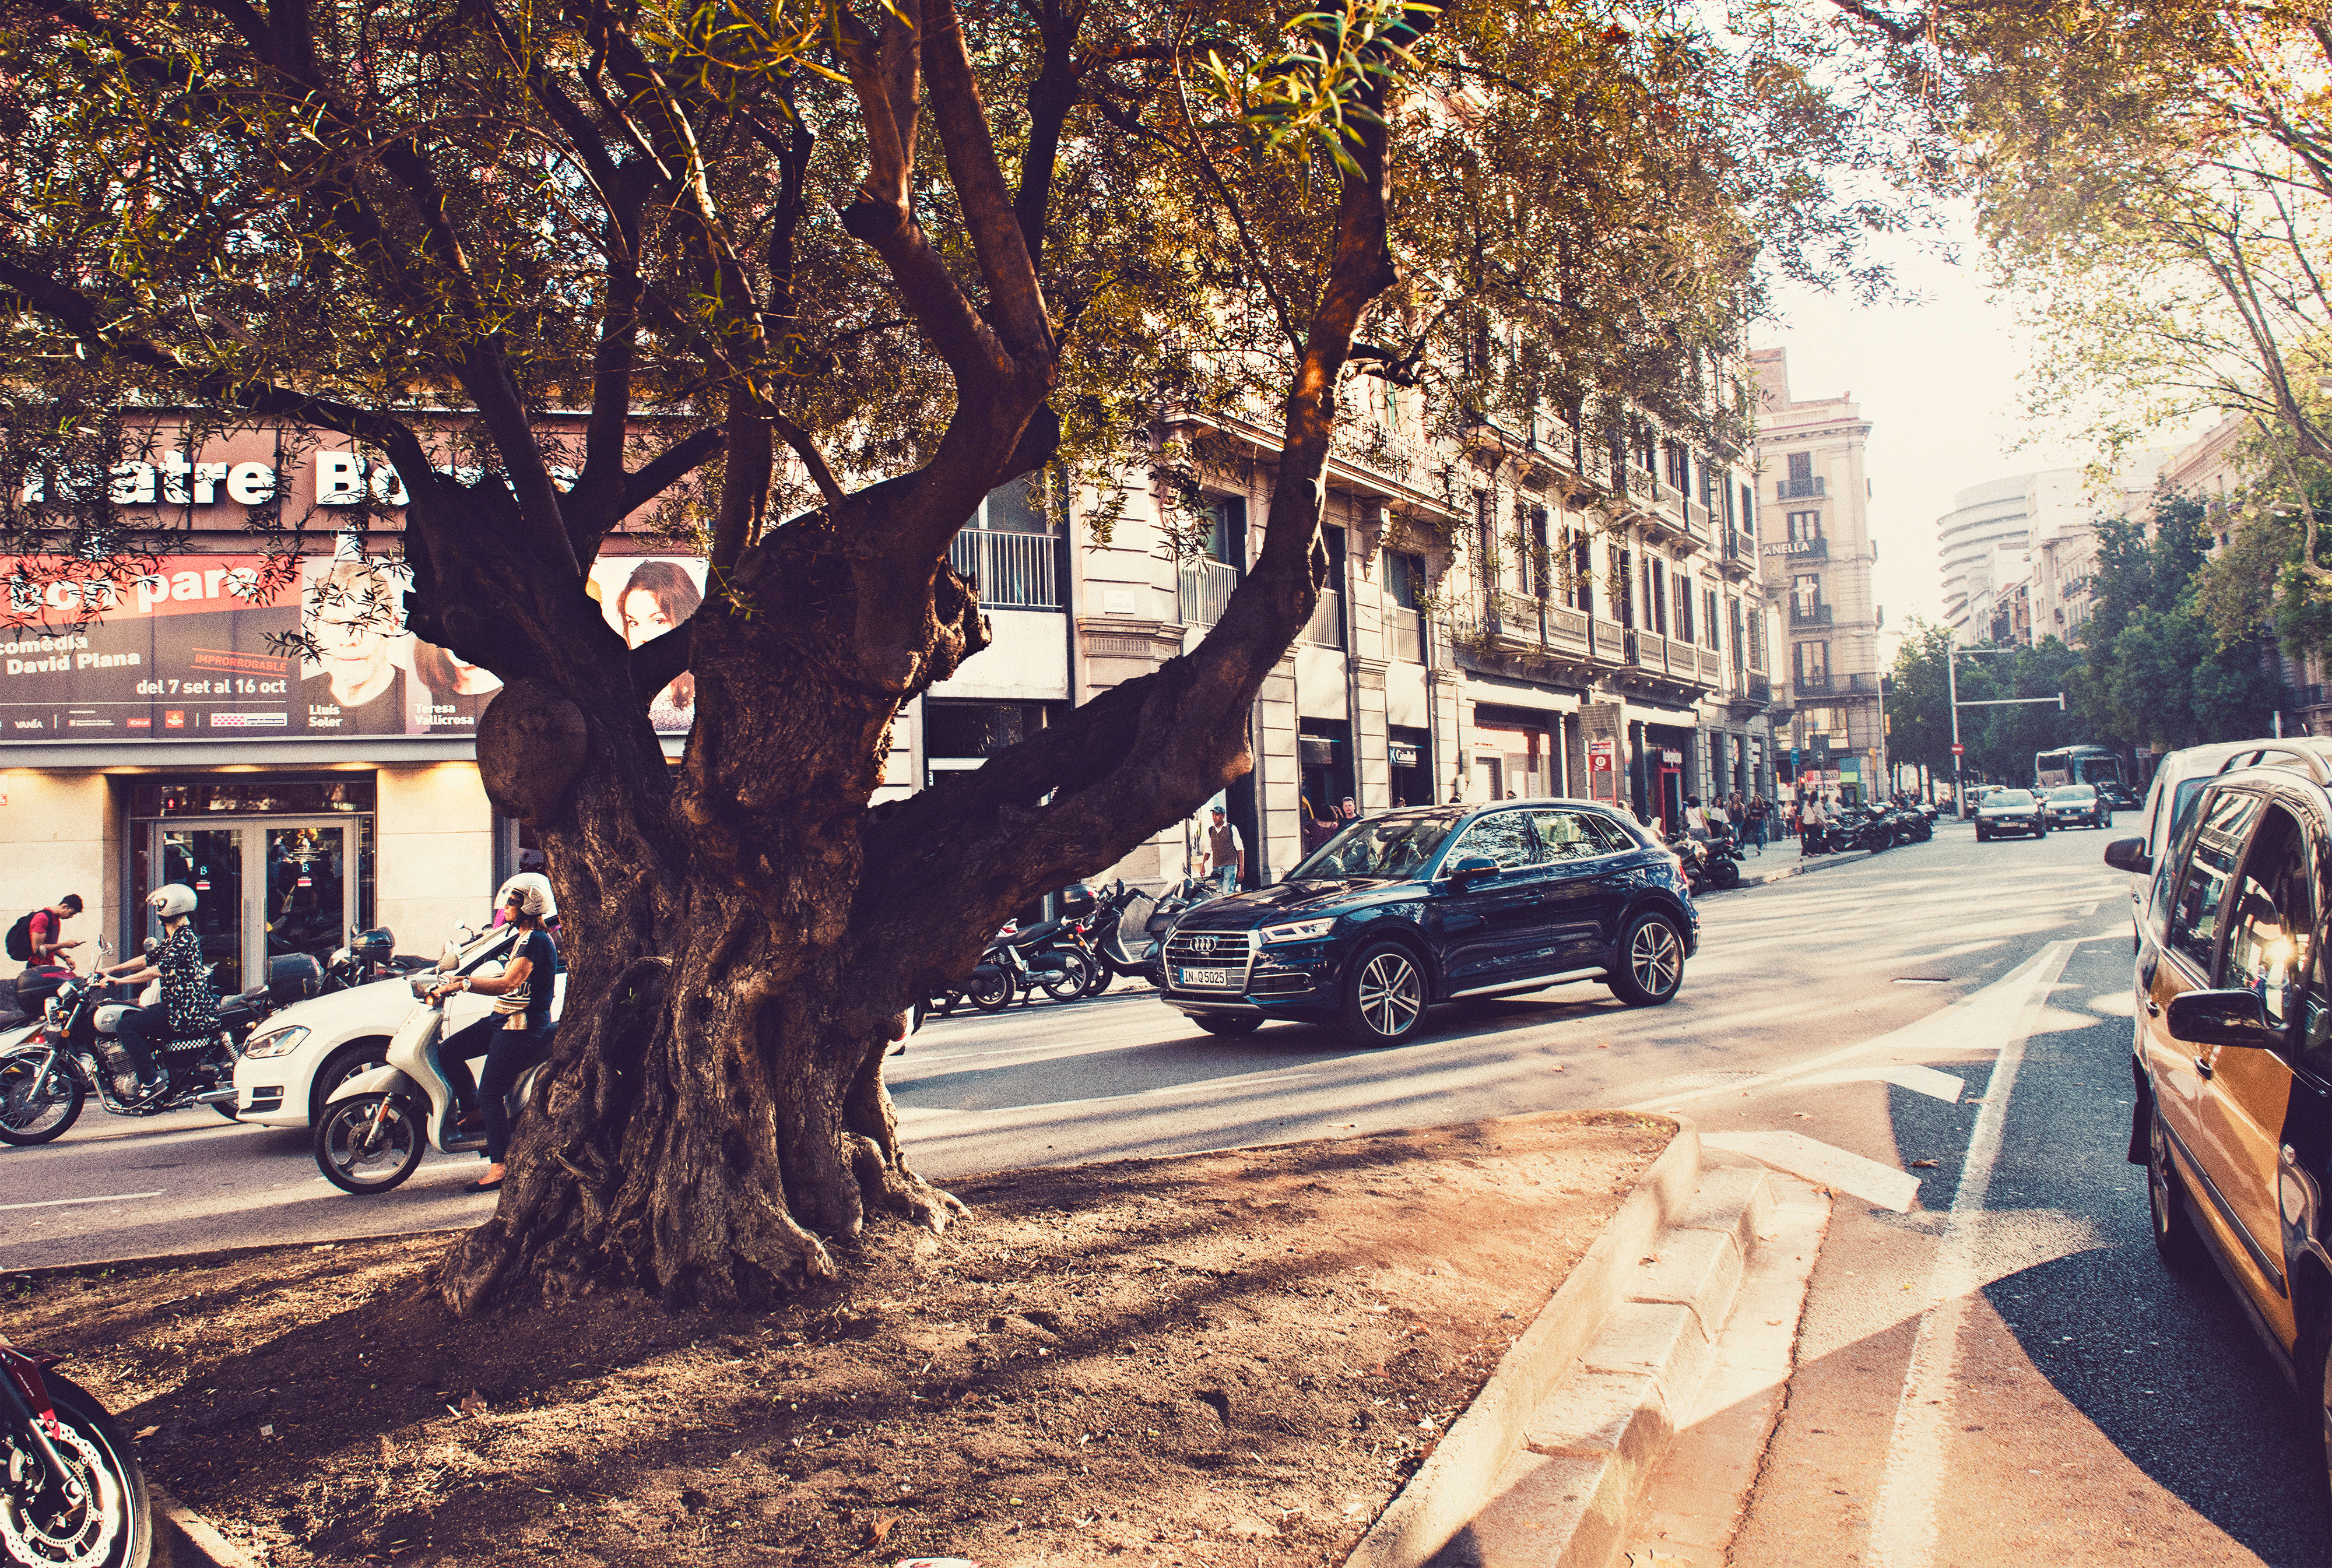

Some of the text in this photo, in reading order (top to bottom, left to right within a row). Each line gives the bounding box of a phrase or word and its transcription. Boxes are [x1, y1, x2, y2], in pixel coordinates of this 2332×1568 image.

[6, 652, 141, 674] David Plana
[194, 653, 287, 672] IMPRORROGABLE
[136, 679, 287, 694] del 7 set al 16 oct
[308, 704, 340, 715] Lluís
[415, 703, 456, 713] Teresa
[308, 716, 343, 728] Soler
[414, 715, 475, 726] Vallicrosa
[1185, 971, 1194, 982] IN
